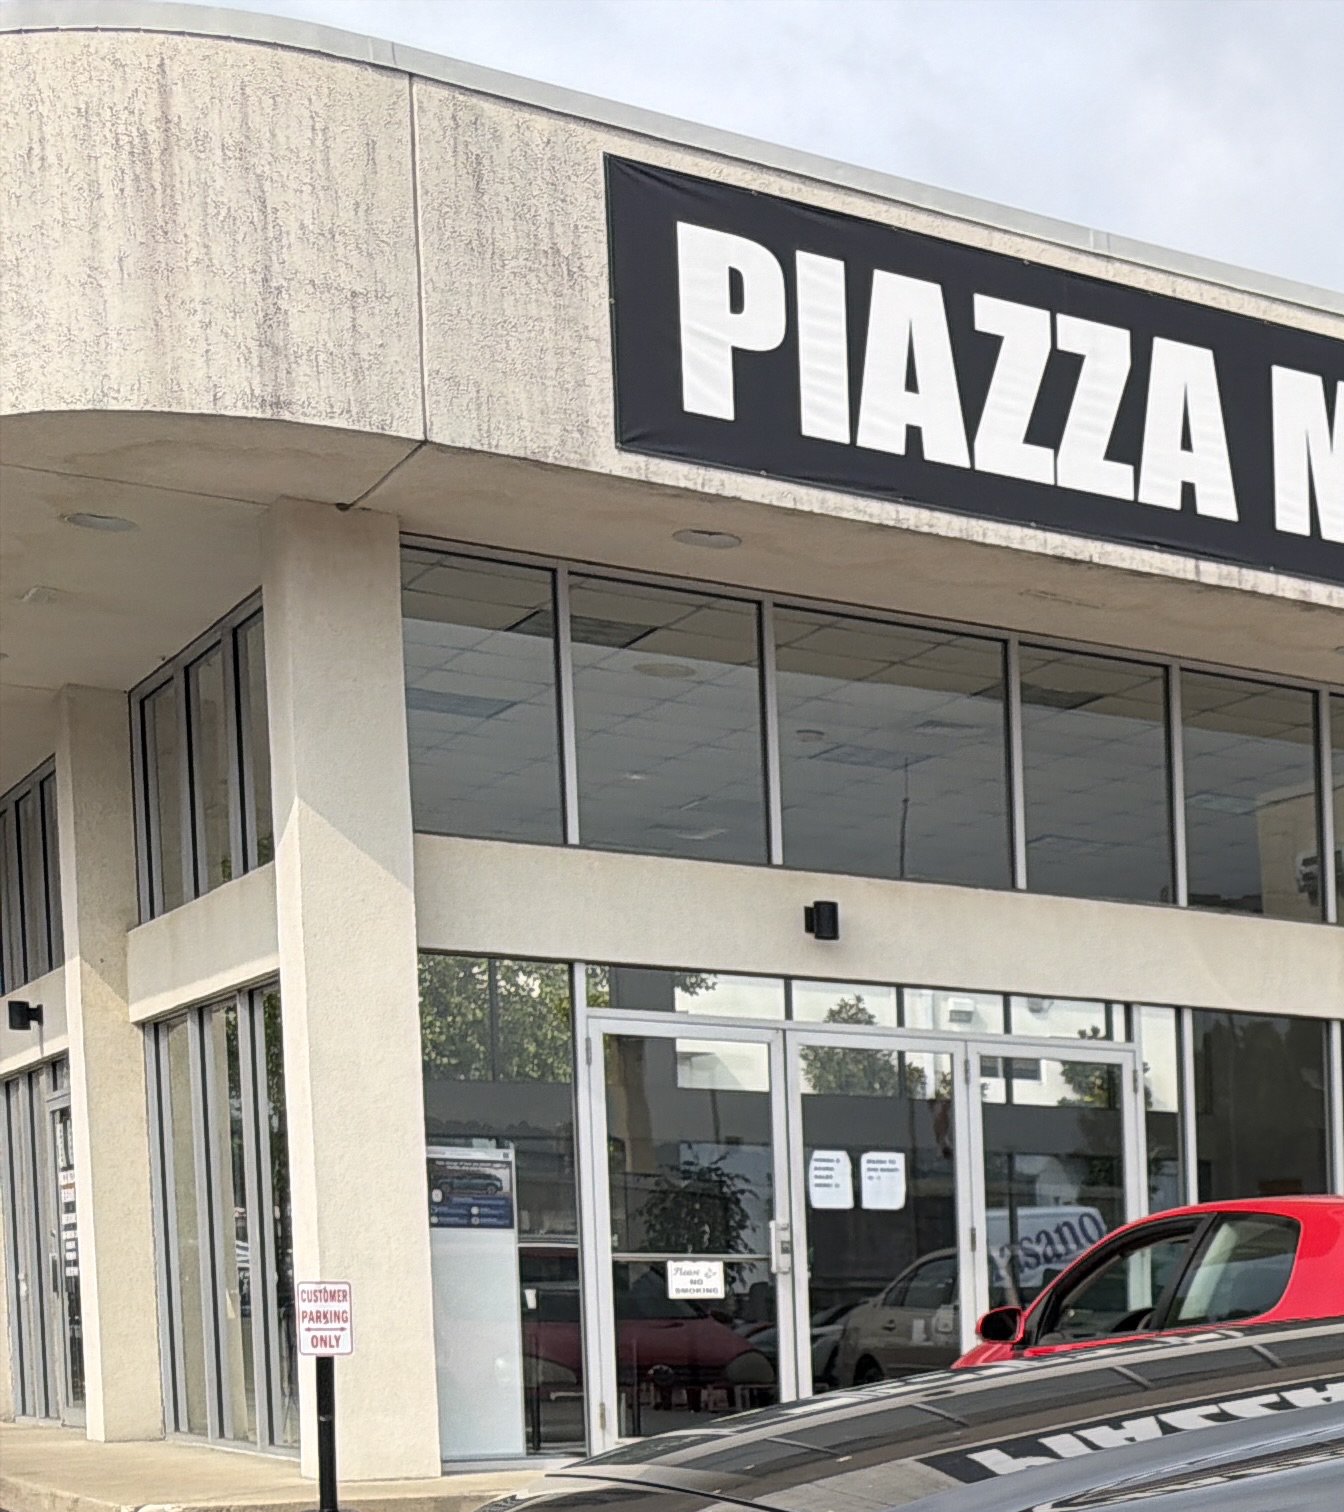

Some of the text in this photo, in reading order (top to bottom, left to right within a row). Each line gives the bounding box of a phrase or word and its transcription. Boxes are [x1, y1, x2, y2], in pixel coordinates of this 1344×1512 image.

[676, 220, 1239, 522] PIAZZA
[300, 1288, 348, 1303] CUSTOMER
[301, 1310, 349, 1324] PARKING
[310, 1334, 341, 1349] ONLY
